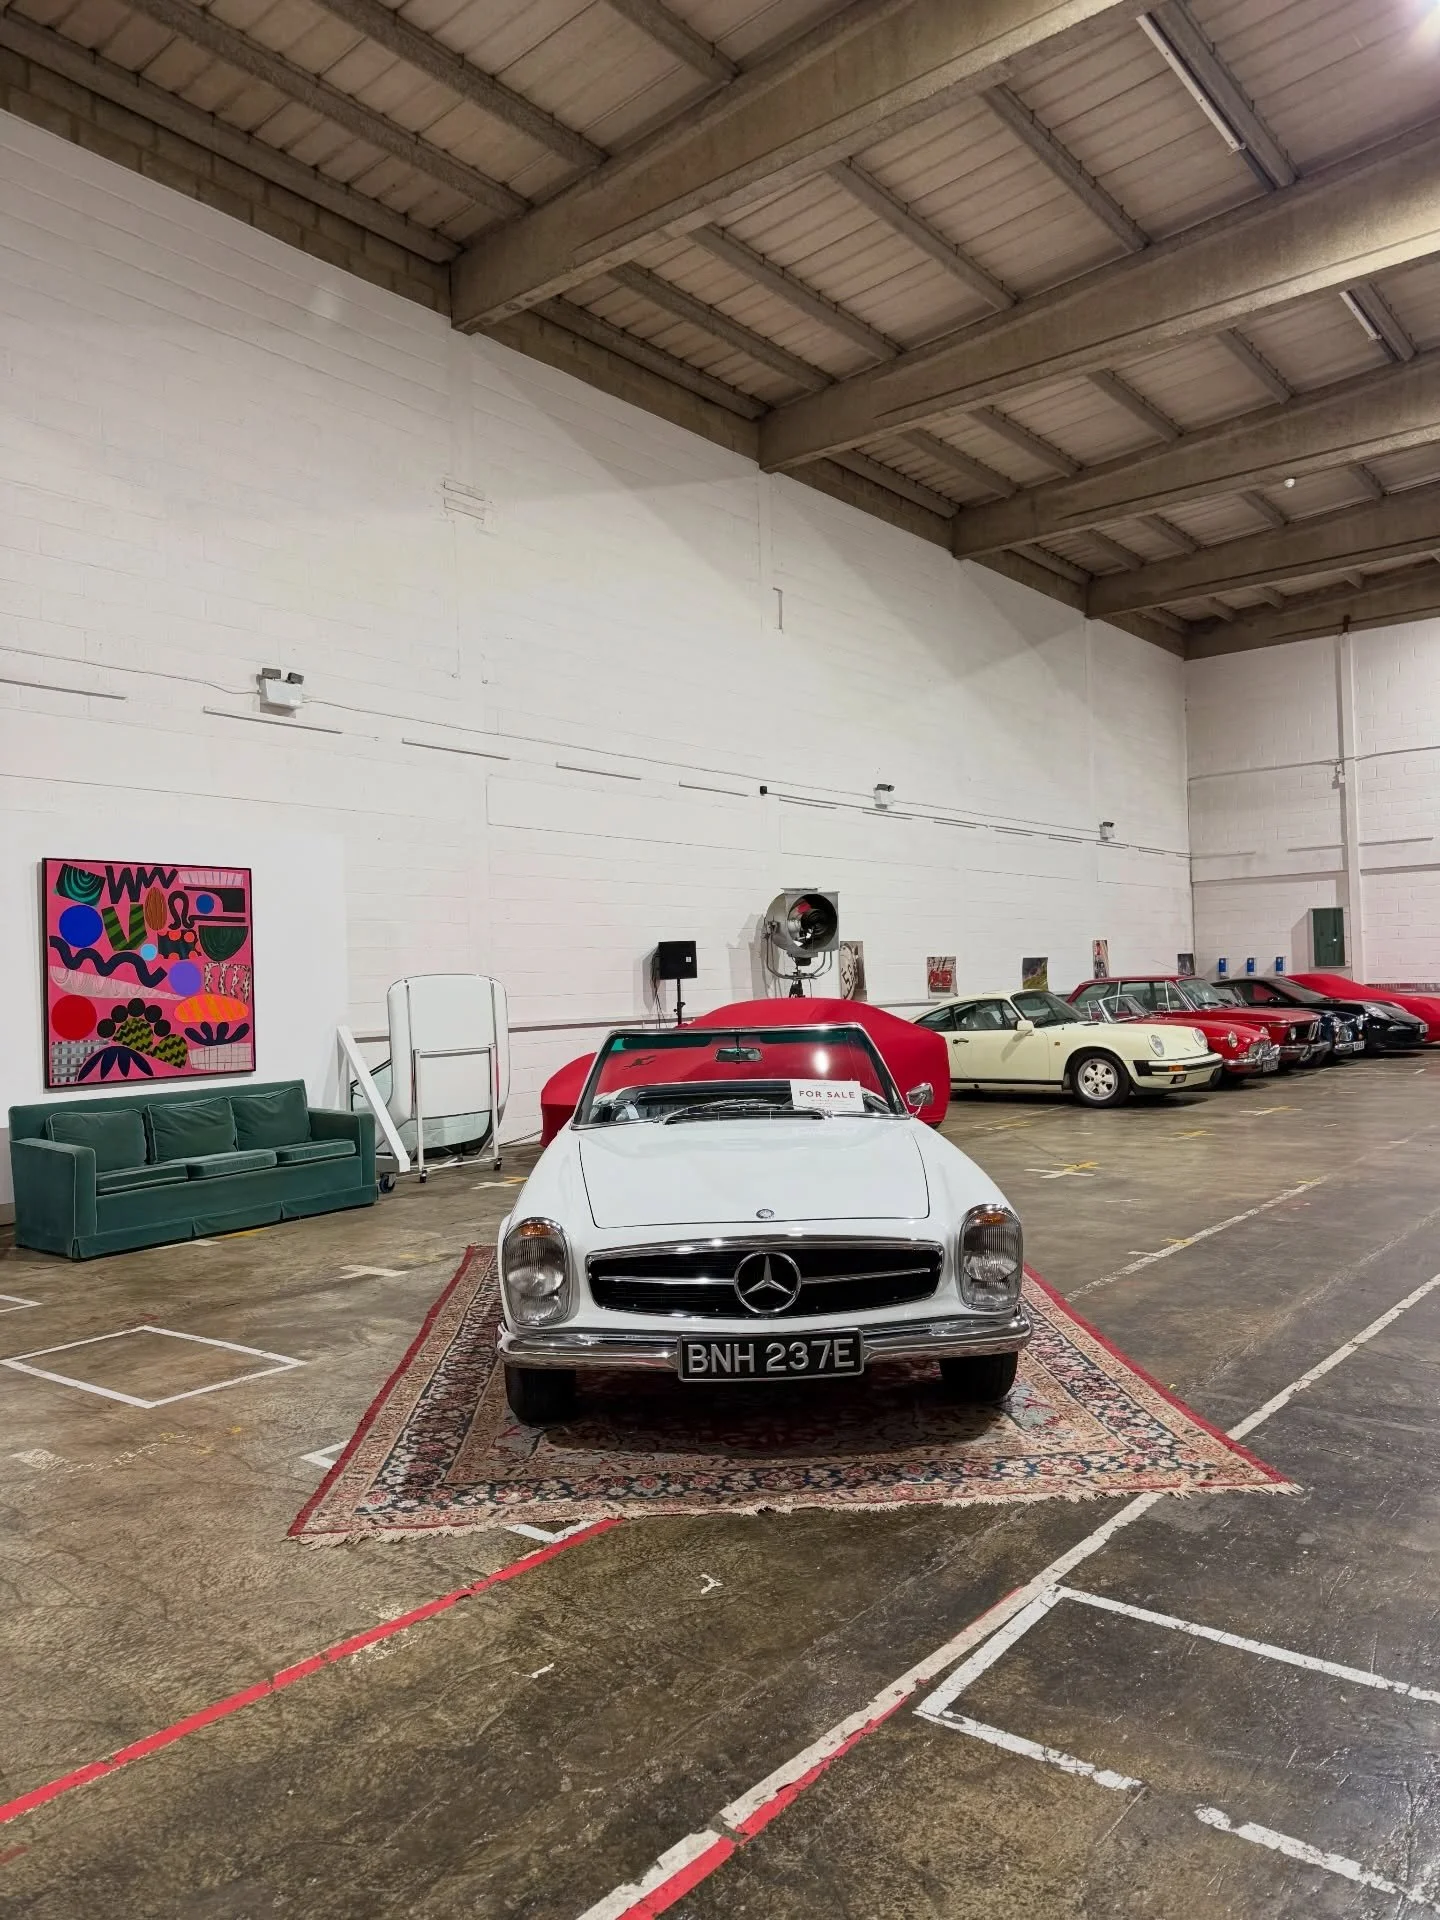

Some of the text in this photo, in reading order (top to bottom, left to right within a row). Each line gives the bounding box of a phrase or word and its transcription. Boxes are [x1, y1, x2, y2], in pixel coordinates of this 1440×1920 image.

[799, 1090, 856, 1099] FOR SALE
[687, 1338, 855, 1374] BNH 237E
